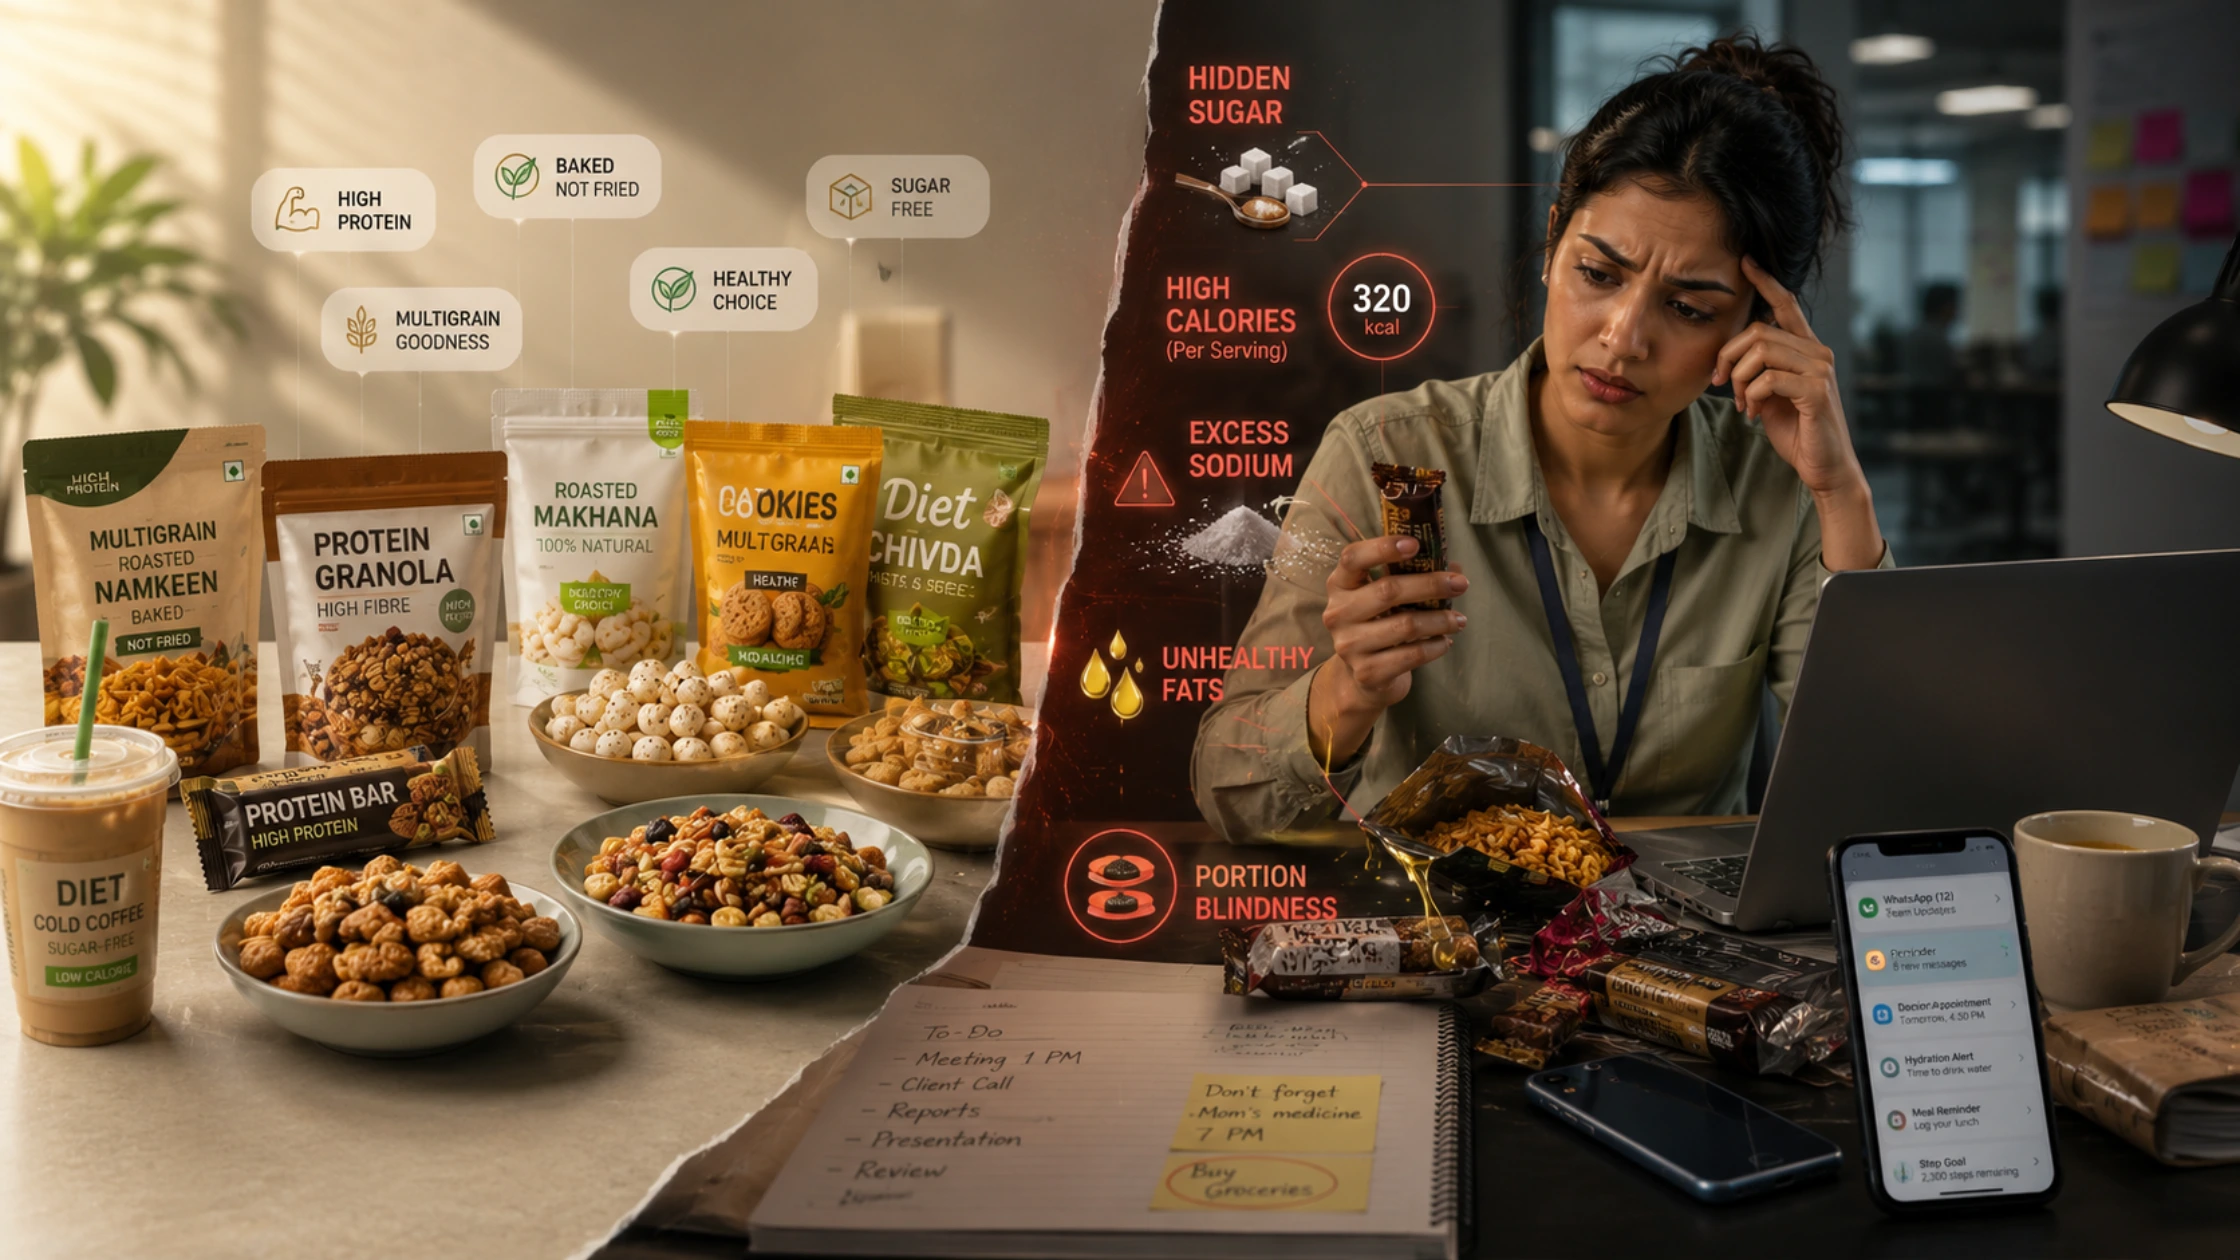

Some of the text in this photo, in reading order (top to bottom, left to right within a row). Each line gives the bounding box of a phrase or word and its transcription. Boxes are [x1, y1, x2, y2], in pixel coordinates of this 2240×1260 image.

[555, 482, 637, 499] ROASTED
[883, 477, 977, 530] Diet
[534, 506, 658, 528] MAKHANA
[90, 521, 217, 551] MULTIGRAIN
[314, 527, 429, 556] PROTEIN
[536, 538, 653, 553] 100% NATURAL
[119, 550, 195, 572] ROASTED
[869, 530, 983, 578] CHIVDA
[316, 558, 454, 590] GRANOLA
[95, 570, 218, 604] NAMKEEN
[132, 605, 184, 625] BAKED
[317, 597, 411, 617] HIGH FIBRE
[127, 633, 191, 651] NOT FRIED
[245, 781, 398, 828] PROTEIN BAR
[251, 817, 358, 850] HIGH PROTEIN
[57, 873, 125, 907] DIET
[1883, 891, 1954, 904] WhatsApp (12)
[34, 903, 145, 933] COLD COFFEE
[48, 931, 135, 955] SUGAR-FREE
[56, 972, 82, 983] LOW
[1971, 1011, 1986, 1019] PM
[916, 1050, 1082, 1072] Meeting 1 PM
[1905, 1052, 1974, 1066] Hydration Alert
[1907, 1068, 1929, 1077] Time
[1931, 1067, 1940, 1076] to
[1968, 1065, 1992, 1074] water
[901, 1075, 1014, 1092] Client Call
[1205, 1083, 1340, 1104] Don't forget
[888, 1102, 981, 1124] Reports
[1198, 1106, 1362, 1120] Mom's medicine
[1912, 1104, 1980, 1117] Meal Reminder
[1197, 1127, 1264, 1142] 7 PM
[1914, 1121, 1931, 1131] Log
[1933, 1120, 1951, 1131] your
[871, 1131, 1021, 1148] Presentation
[854, 1160, 948, 1180] Review
[1191, 1163, 1237, 1182] Buy
[1919, 1156, 1966, 1169] Step Goal
[1949, 1170, 1973, 1182] steps
[1205, 1182, 1313, 1199] Groceries
